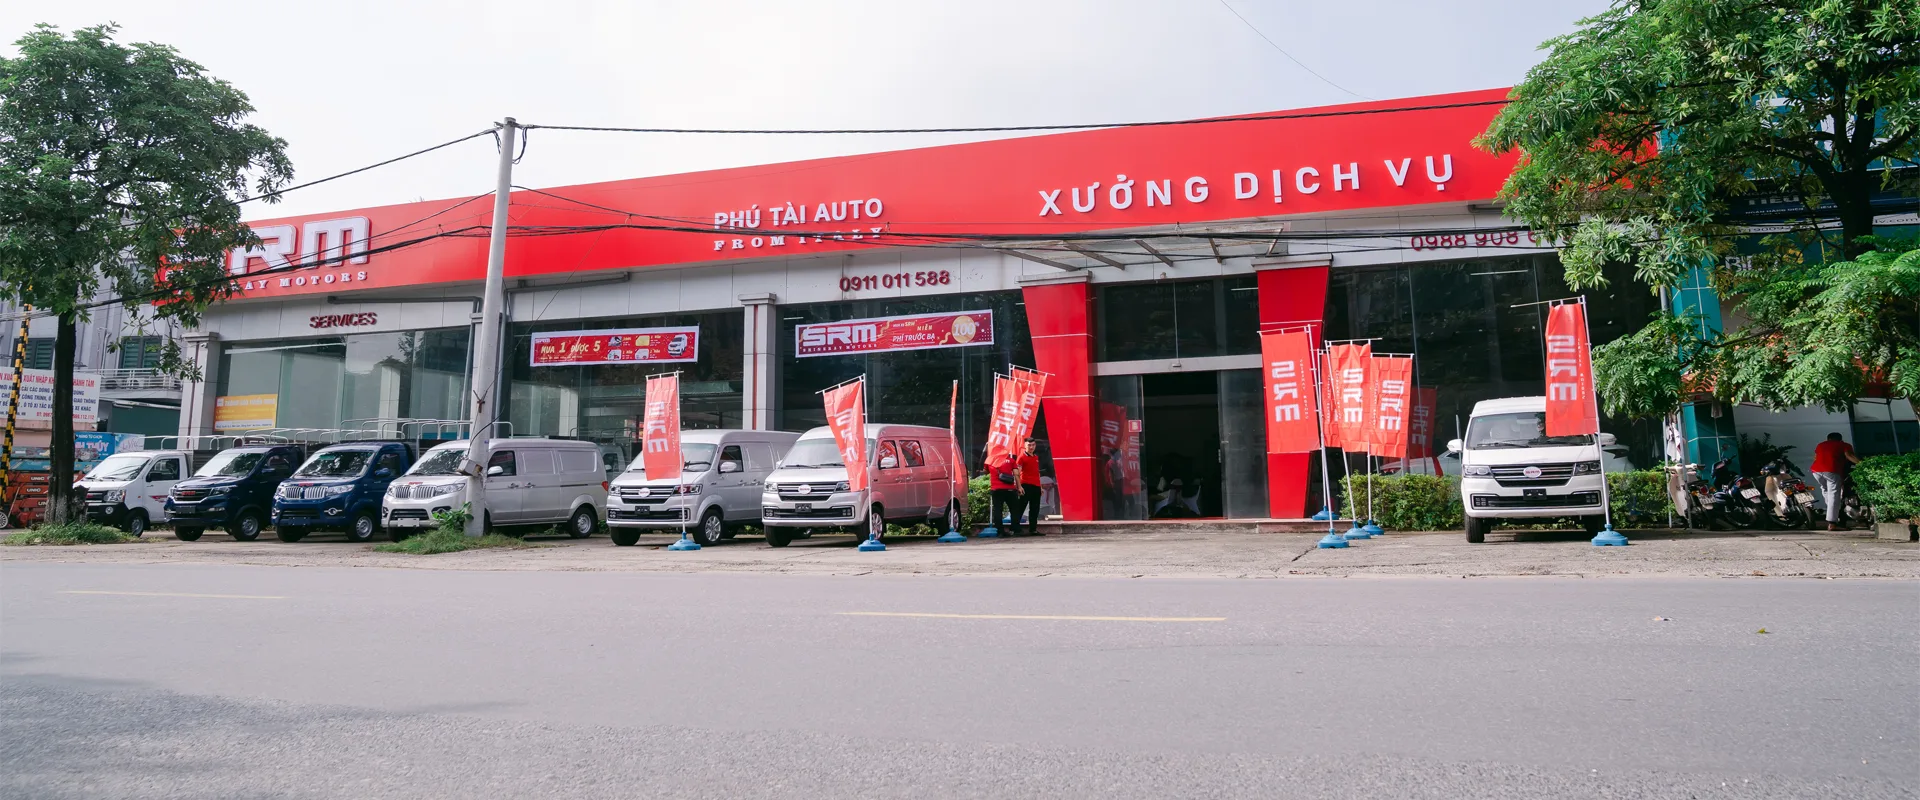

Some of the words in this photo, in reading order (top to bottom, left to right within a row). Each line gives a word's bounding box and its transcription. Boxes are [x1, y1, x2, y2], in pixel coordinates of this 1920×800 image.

[1039, 174, 1209, 216] XƯỞNG
[1234, 162, 1360, 203] DỊCH
[1384, 154, 1453, 191] VỤ
[714, 204, 761, 230] PHÚ
[769, 202, 806, 225] TÀI
[814, 198, 883, 222] AUTO
[714, 235, 785, 251] FROM
[1411, 232, 1467, 251] 0988
[1474, 231, 1519, 247] 908
[280, 271, 368, 287] MOTORS
[840, 275, 877, 292] 0911
[882, 272, 909, 289] 011
[915, 270, 950, 287] 588
[309, 311, 378, 329] SERVICES
[803, 324, 877, 347] SRM
[559, 342, 566, 353] 1
[593, 340, 601, 352] 5
